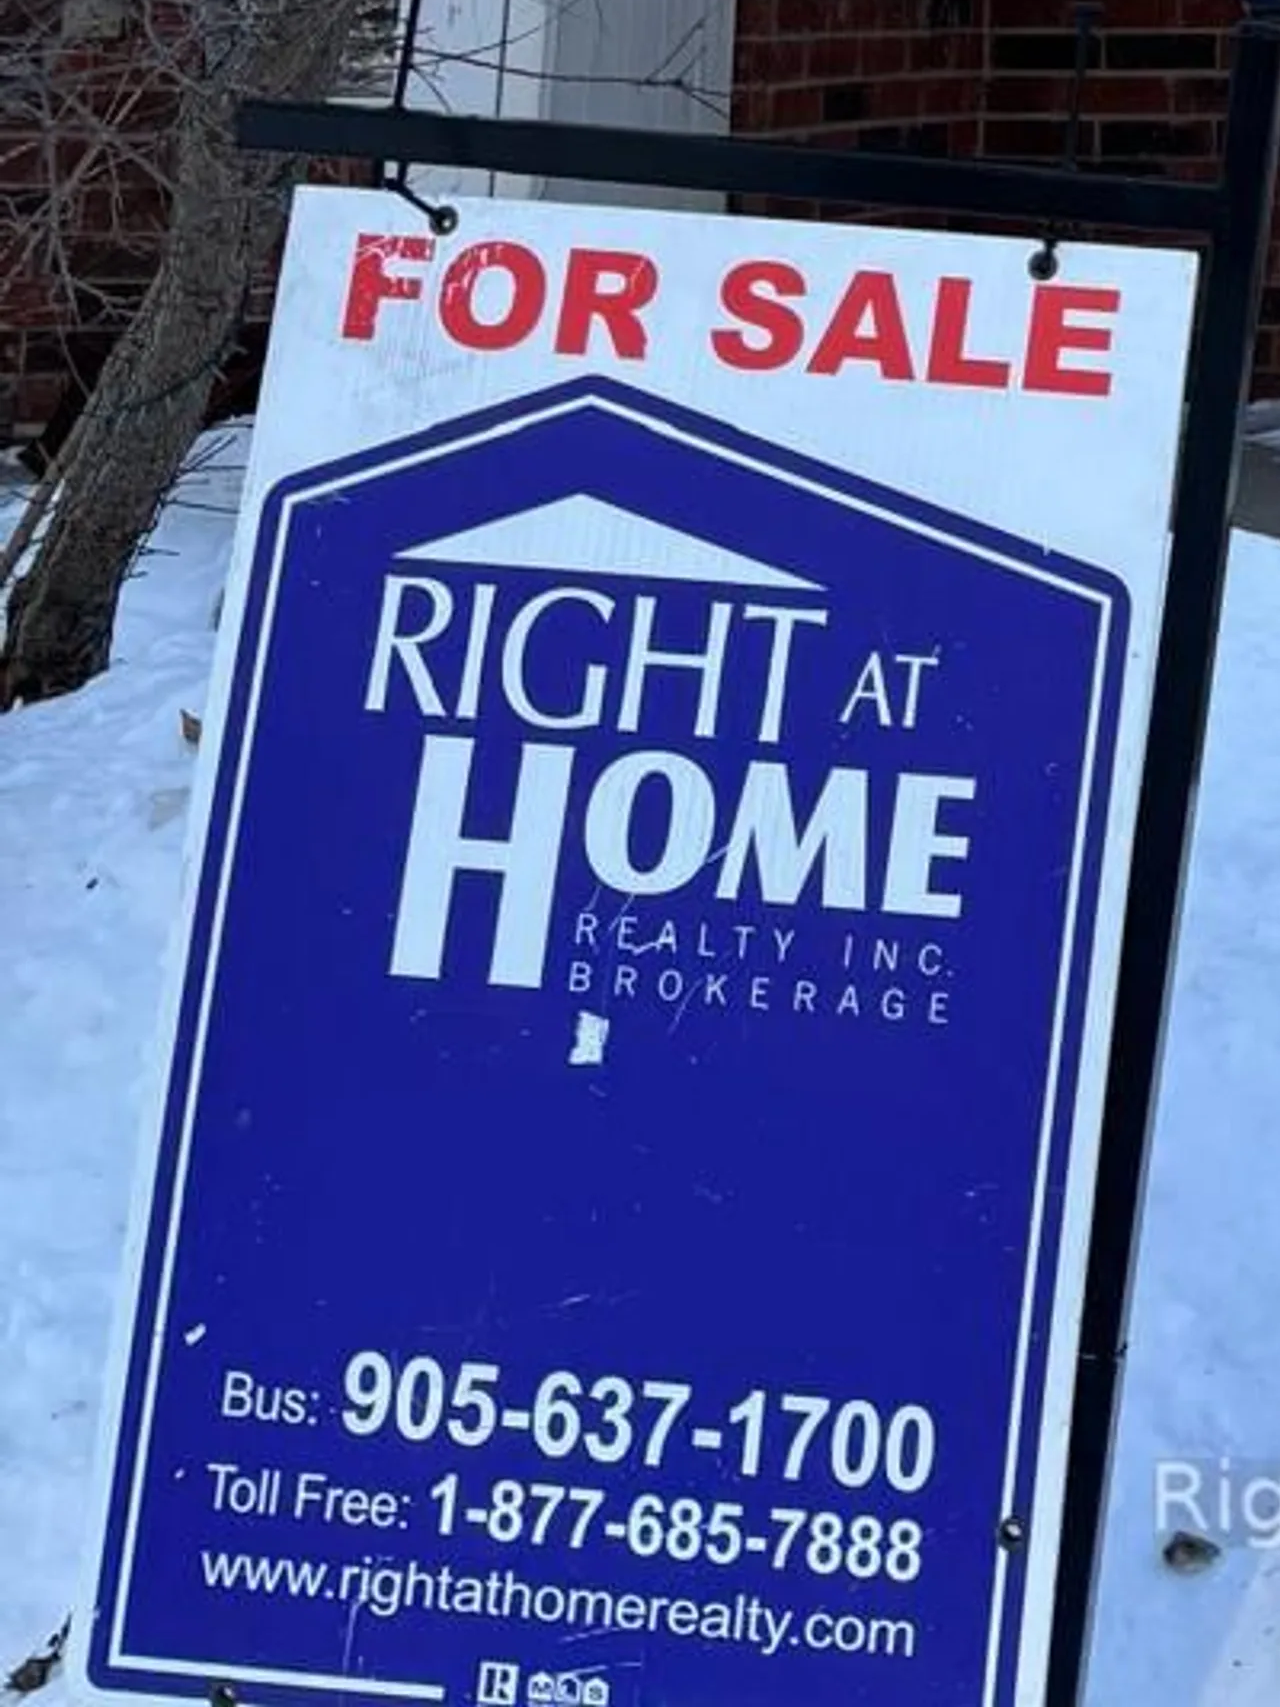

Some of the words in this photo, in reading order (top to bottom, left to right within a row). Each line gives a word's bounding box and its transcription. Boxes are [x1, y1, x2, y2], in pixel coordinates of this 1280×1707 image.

[341, 233, 657, 358] FOR
[710, 260, 1122, 397] SALE
[362, 572, 830, 745] RIGHT
[838, 649, 941, 730] AT
[387, 733, 978, 990] HOME
[567, 960, 949, 1025] BROKERAGE
[573, 911, 795, 962] REALTY
[842, 934, 954, 977] INC.
[220, 1370, 320, 1426] Bus:
[341, 1349, 937, 1494] 905-637-1700
[206, 1462, 282, 1517] Toll
[293, 1472, 411, 1529] Free:
[428, 1472, 924, 1584] 1-877-685-7888
[201, 1548, 916, 1658] www.rightathomerealty.com
